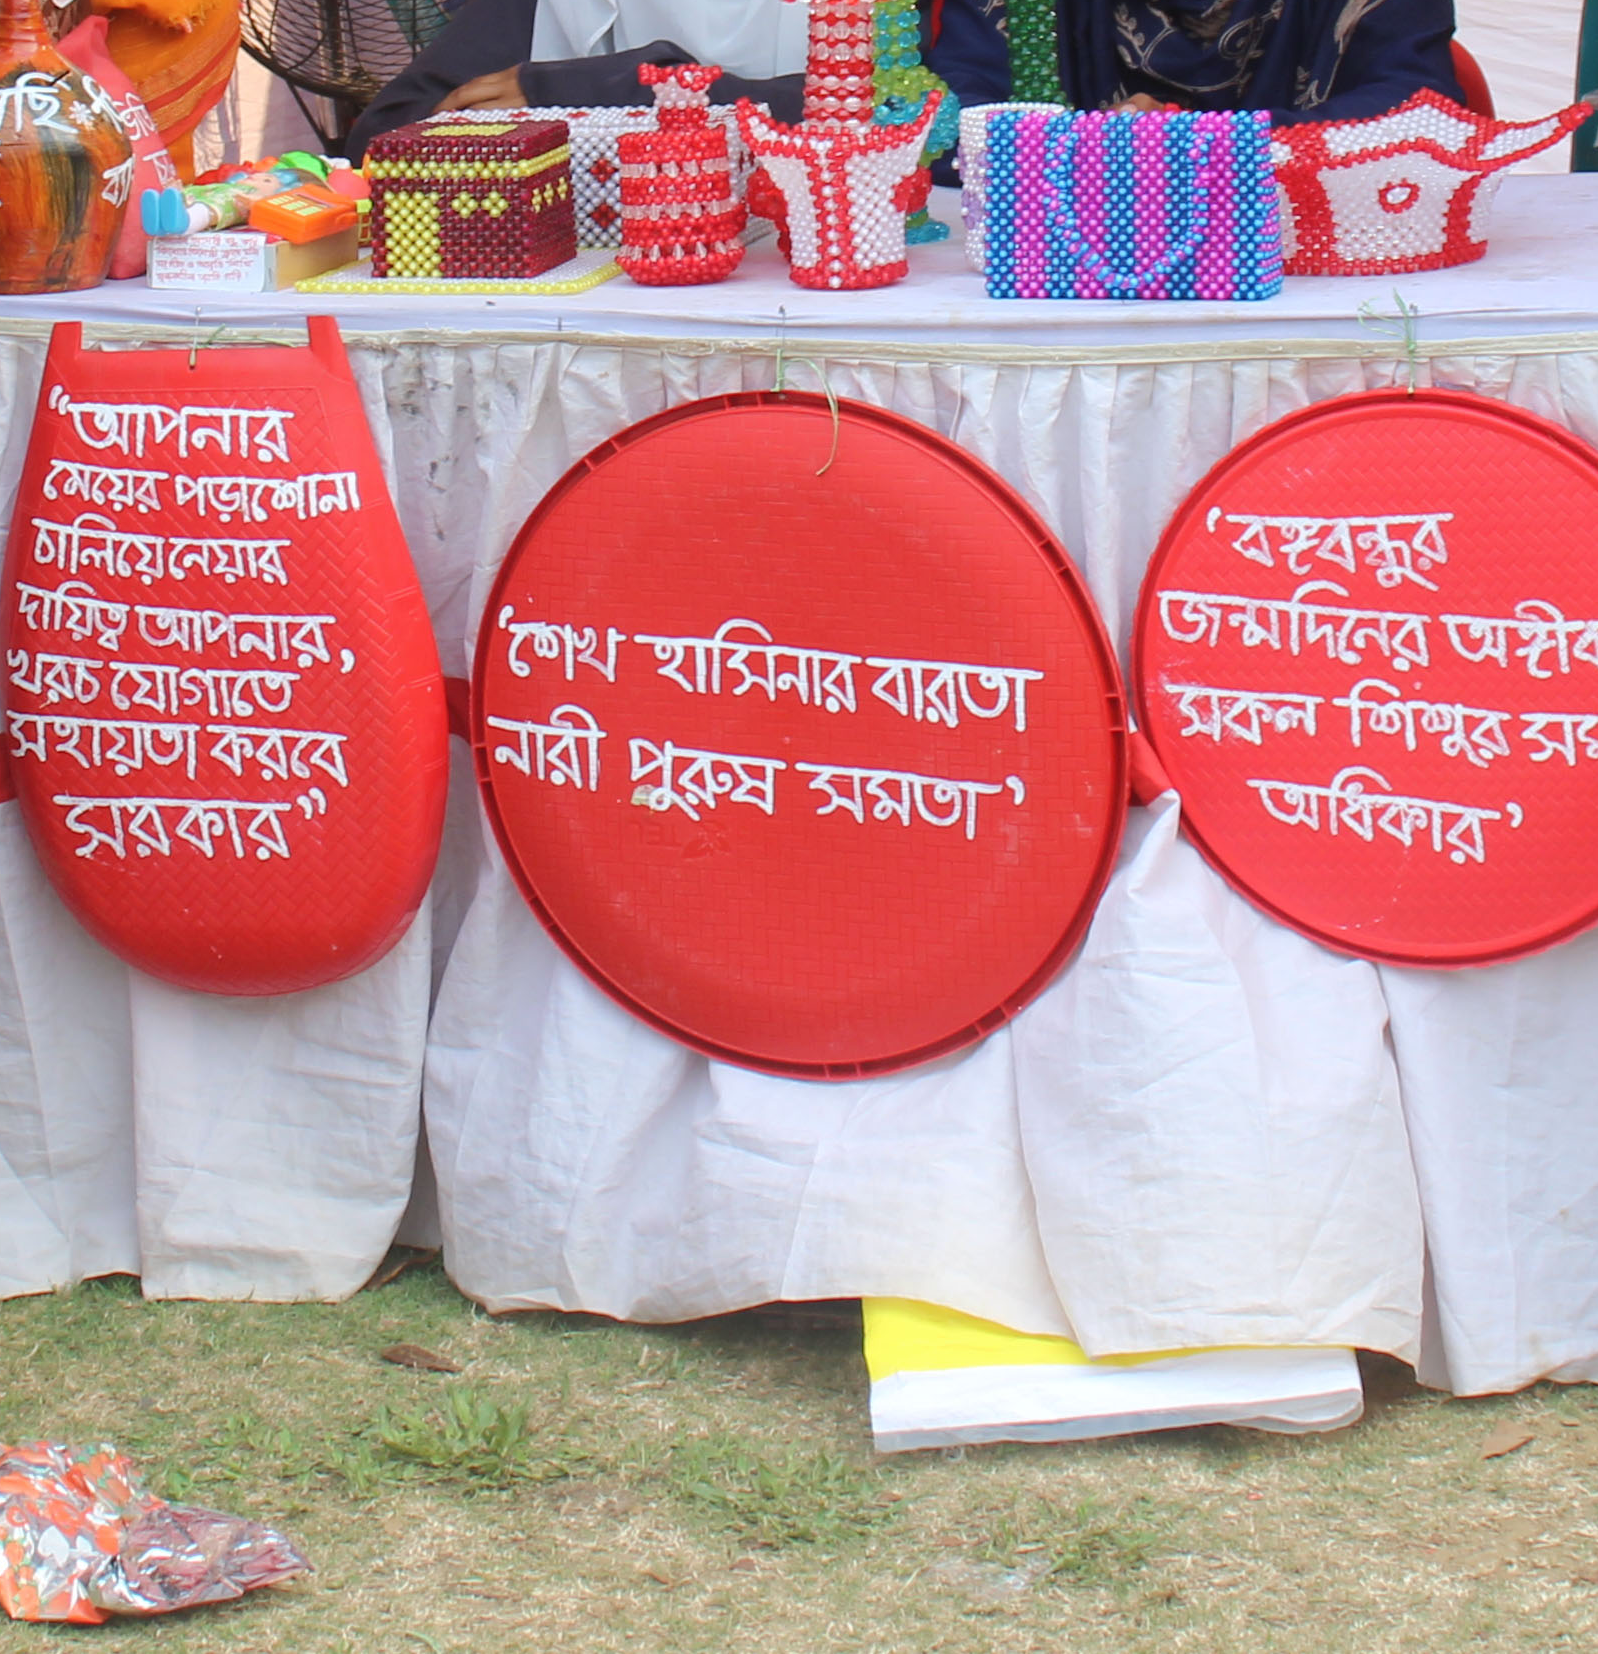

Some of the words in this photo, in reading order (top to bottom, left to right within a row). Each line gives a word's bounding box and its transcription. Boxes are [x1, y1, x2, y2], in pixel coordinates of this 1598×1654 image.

[41, 460, 168, 513] মেয়ের
[175, 471, 361, 523] পড়াশোনা
[31, 513, 166, 585] চালিয়ে
[167, 537, 292, 586] নেয়ার
[16, 581, 129, 652] দায়িত্ব
[1157, 580, 1431, 672] জন্মদিনের
[6, 649, 103, 703] খরচ
[108, 661, 301, 719] যোগাতে
[634, 618, 863, 714] হাসিনার
[865, 656, 1044, 732] বারতা
[7, 711, 200, 780] সহায়তা
[206, 724, 348, 788] করবে
[1165, 683, 1324, 745] সকল
[1332, 678, 1511, 769] শিশুর
[487, 704, 607, 792] নারী
[629, 737, 788, 822] পুরুষ
